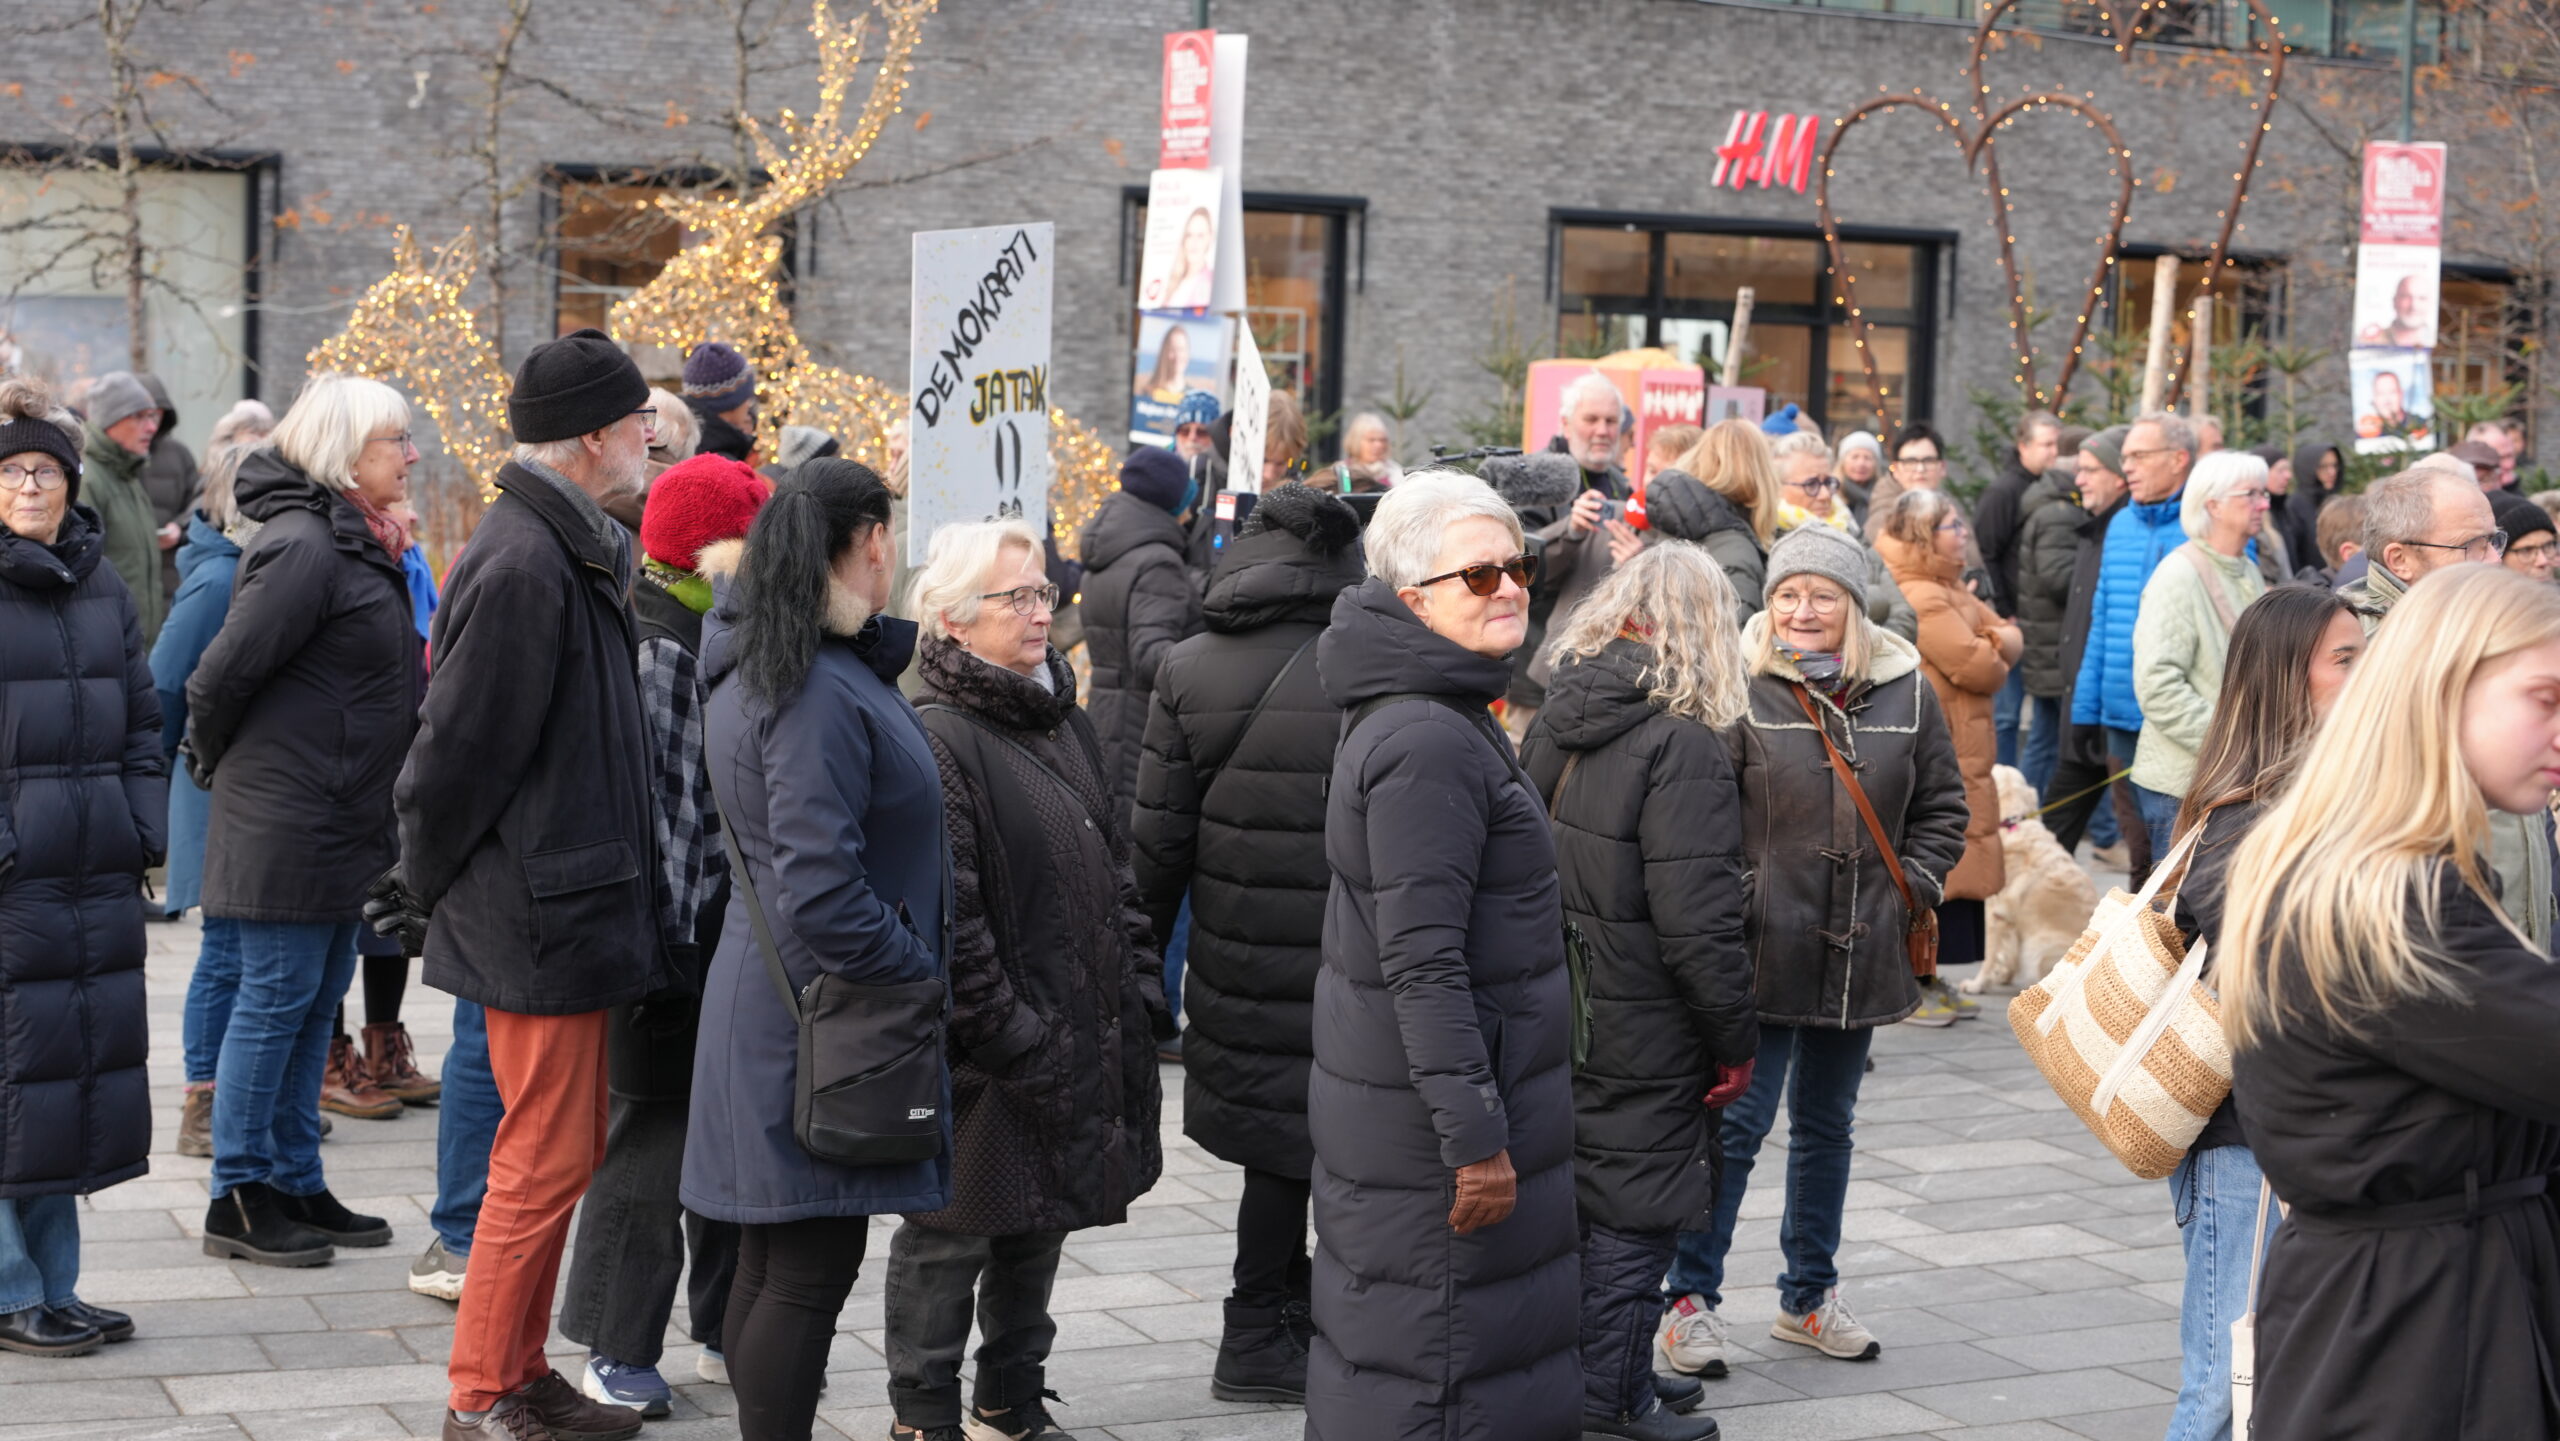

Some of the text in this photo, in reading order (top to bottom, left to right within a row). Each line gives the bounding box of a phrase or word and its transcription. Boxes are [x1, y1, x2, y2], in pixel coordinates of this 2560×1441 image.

[1711, 109, 1820, 195] H&M
[915, 229, 1037, 428] DEMOKRATI
[970, 363, 1047, 427] JATAK
